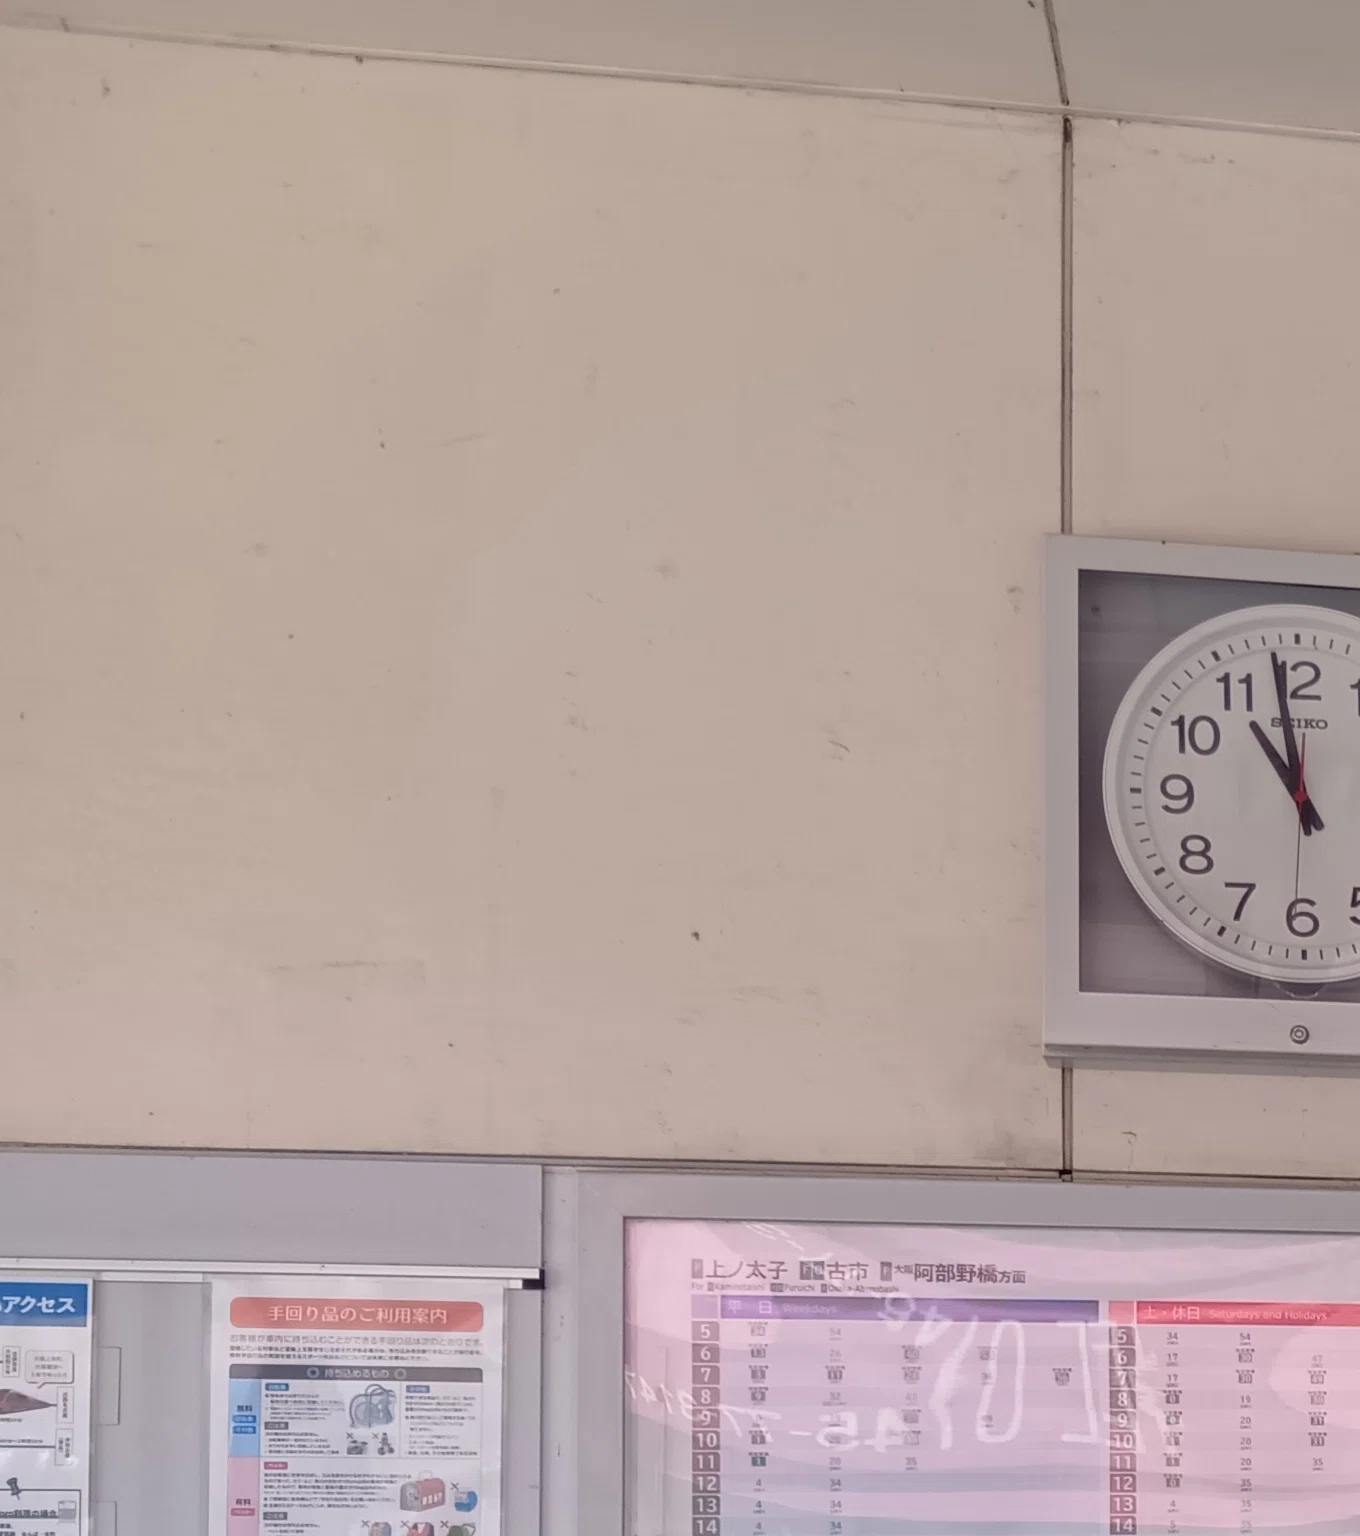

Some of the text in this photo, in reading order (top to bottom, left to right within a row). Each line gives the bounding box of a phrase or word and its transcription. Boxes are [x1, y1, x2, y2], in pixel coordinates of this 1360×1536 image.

[1216, 671, 1254, 712] 11
[1277, 660, 1322, 701] 12
[1171, 714, 1220, 756] 10
[1271, 717, 1328, 730] SEIKO
[1160, 774, 1195, 814] 9
[1179, 834, 1214, 875] 8
[1224, 882, 1256, 921] 7
[1286, 898, 1319, 937] 6
[706, 1260, 1026, 1284] 上ノ太子 古市 大阪阿部野橋方面
[2, 1296, 76, 1314] アクセス
[268, 1305, 448, 1324] 手回り品のご利用案内
[697, 1475, 718, 1491] 12
